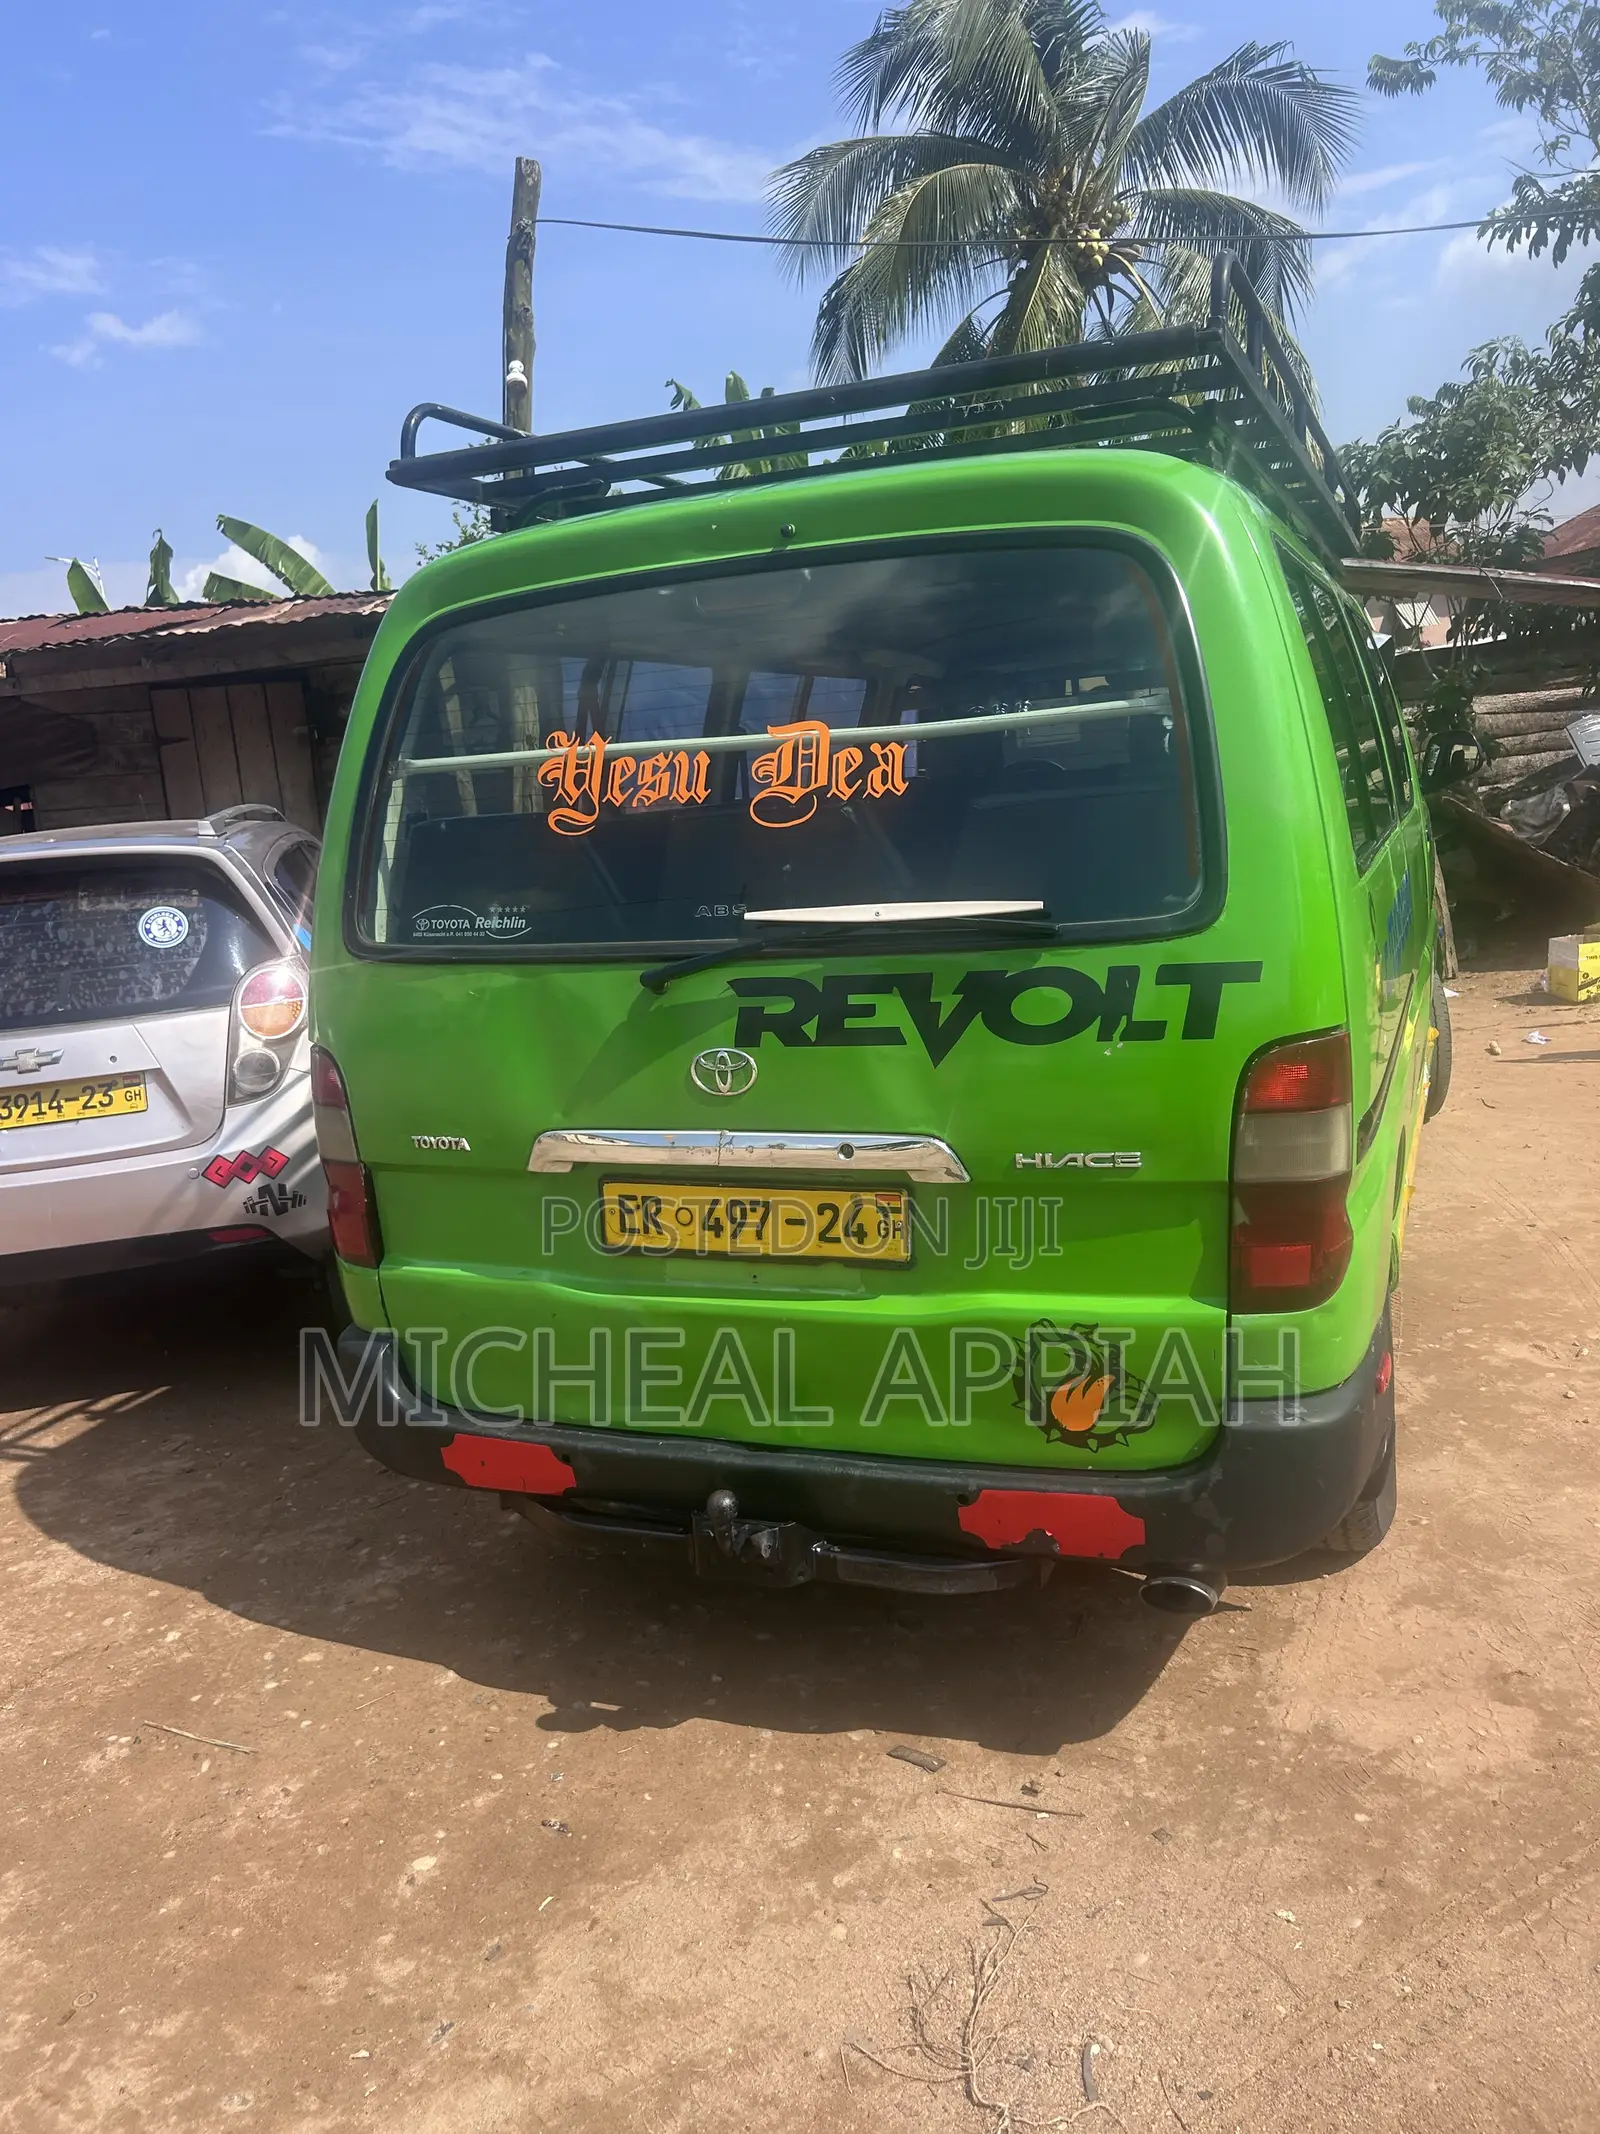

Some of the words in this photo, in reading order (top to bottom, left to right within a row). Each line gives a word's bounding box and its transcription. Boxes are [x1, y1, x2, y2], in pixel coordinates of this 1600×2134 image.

[537, 730, 711, 836] Yesu
[694, 904, 748, 918] ABS
[431, 919, 471, 929] TOYOTA
[475, 916, 526, 929] Reichlin
[726, 960, 1264, 1069] REVOLT
[124, 1089, 142, 1102] GH
[411, 1135, 471, 1151] TOYOTA
[1014, 1151, 1142, 1169] HIACE
